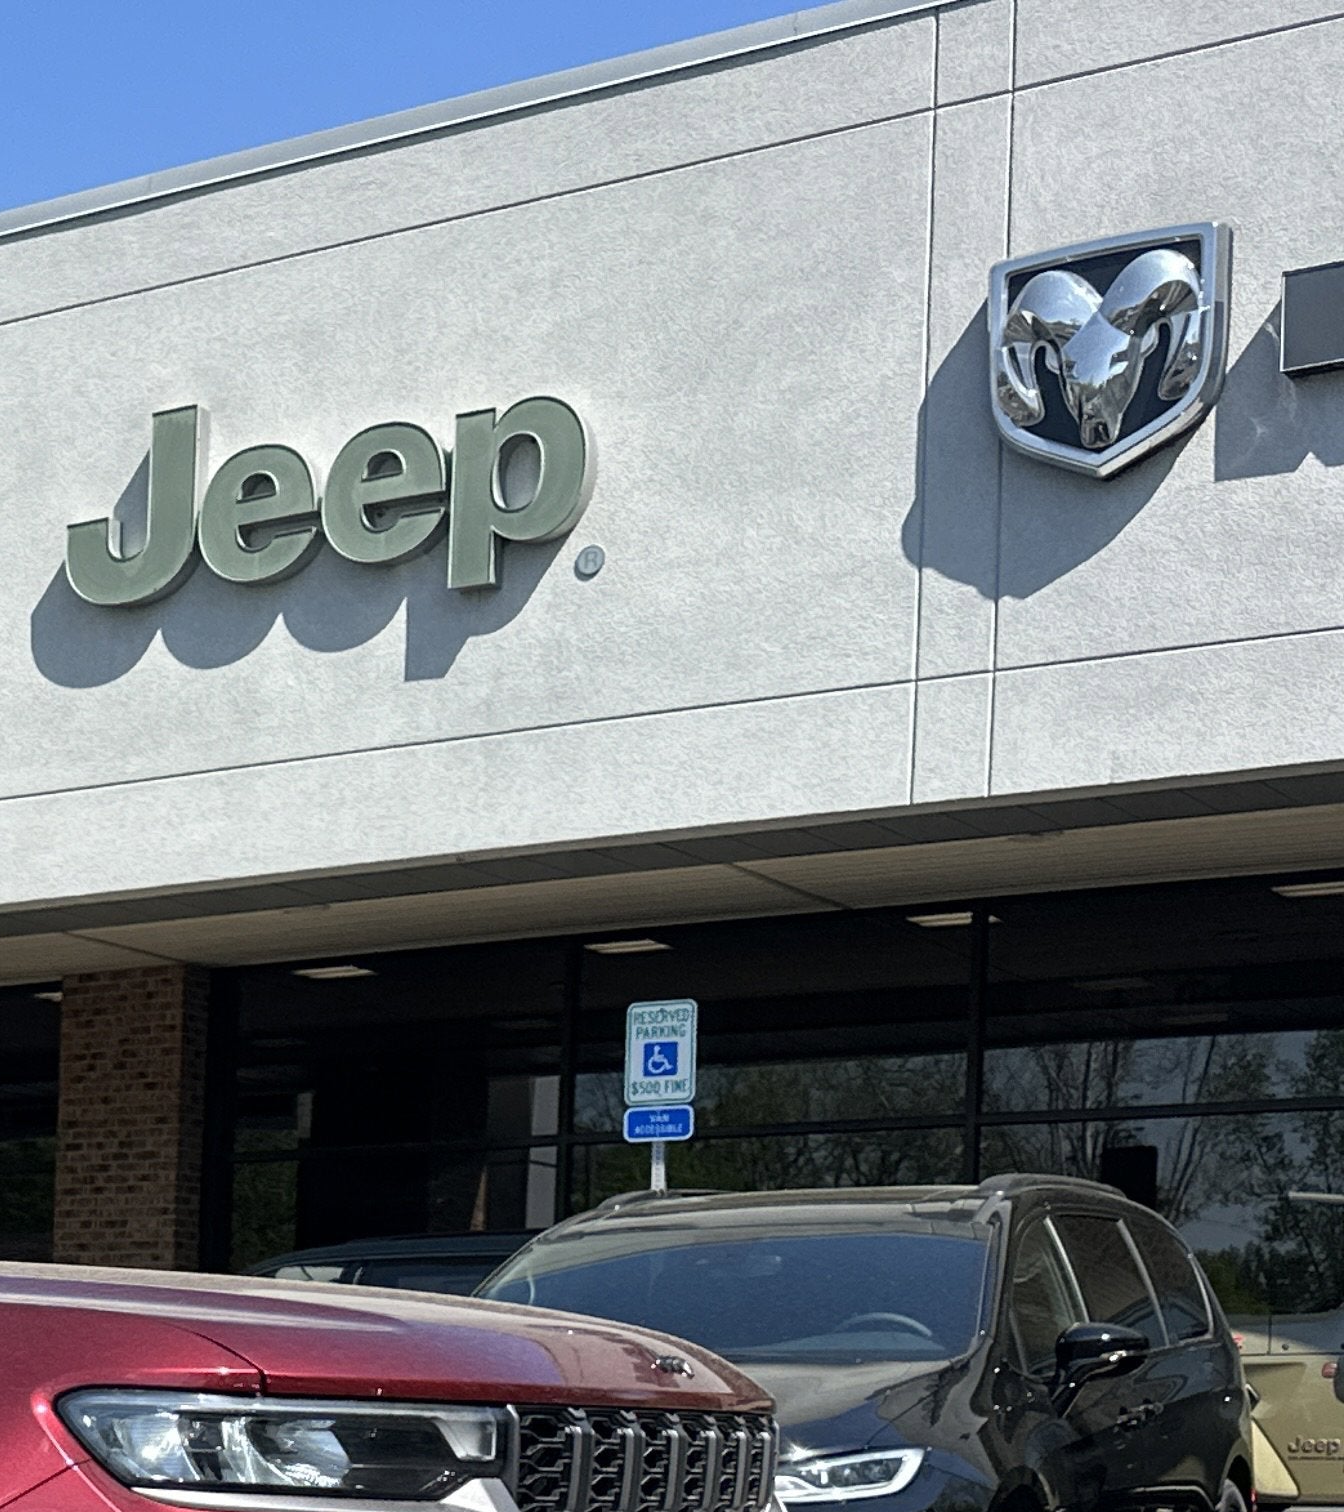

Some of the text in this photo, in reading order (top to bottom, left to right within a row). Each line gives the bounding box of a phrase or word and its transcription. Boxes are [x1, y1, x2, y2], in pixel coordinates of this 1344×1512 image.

[65, 395, 594, 606] Jeep
[633, 1007, 690, 1026] RESERVED
[635, 1023, 687, 1040] PARKING
[631, 1078, 689, 1096] $500 FINE
[1287, 1434, 1341, 1456] Jeep
